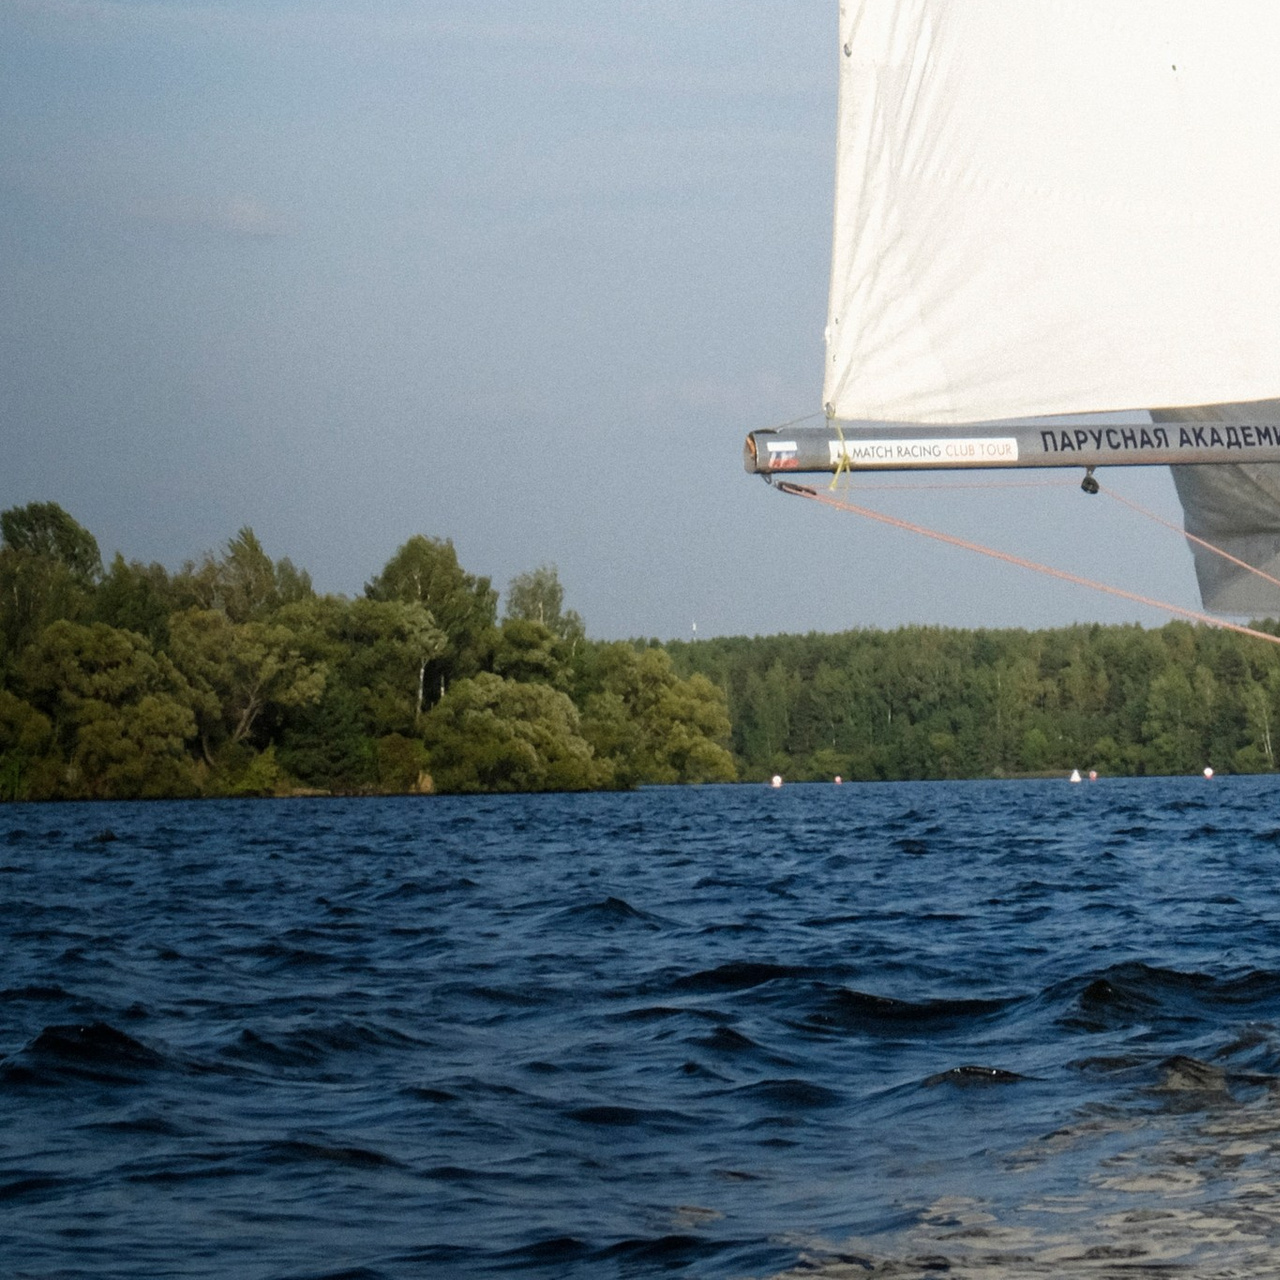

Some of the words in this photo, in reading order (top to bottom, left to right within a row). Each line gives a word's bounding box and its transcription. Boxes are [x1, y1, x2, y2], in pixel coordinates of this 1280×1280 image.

[1040, 427, 1169, 452] ПАРУСНАЯ
[852, 445, 893, 459] MATCH
[896, 444, 942, 458] RACING
[945, 444, 975, 457] CLUB
[979, 443, 1013, 455] TOUR
